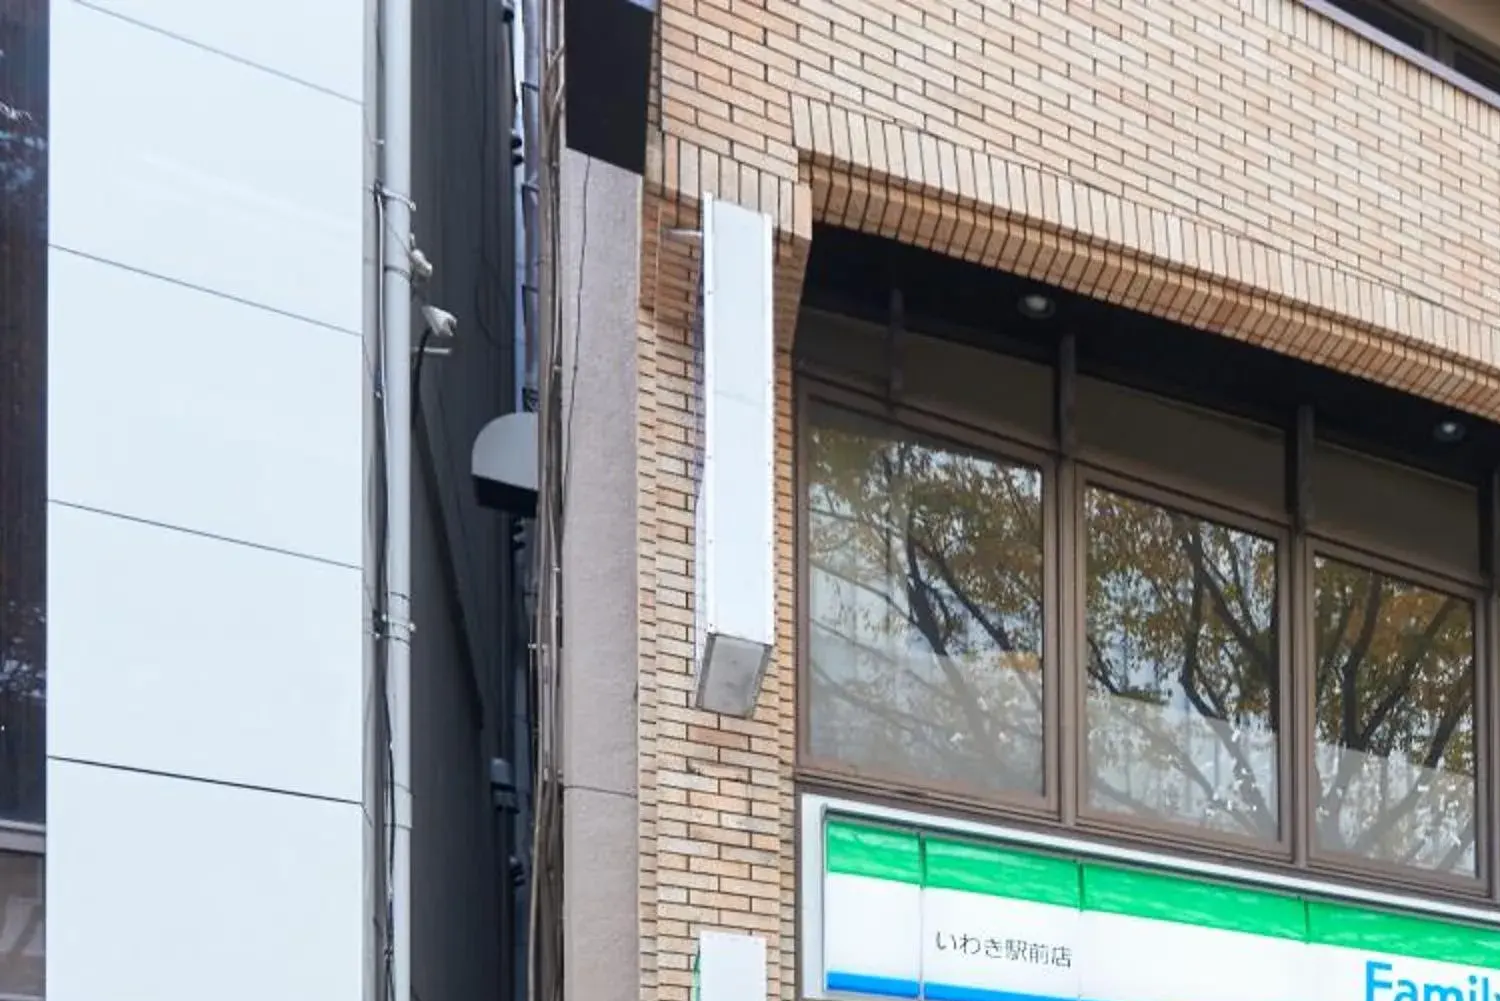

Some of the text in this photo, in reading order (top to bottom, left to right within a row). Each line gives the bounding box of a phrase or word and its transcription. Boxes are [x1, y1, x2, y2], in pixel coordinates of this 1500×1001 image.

[934, 930, 1072, 968] いわき駅前店
